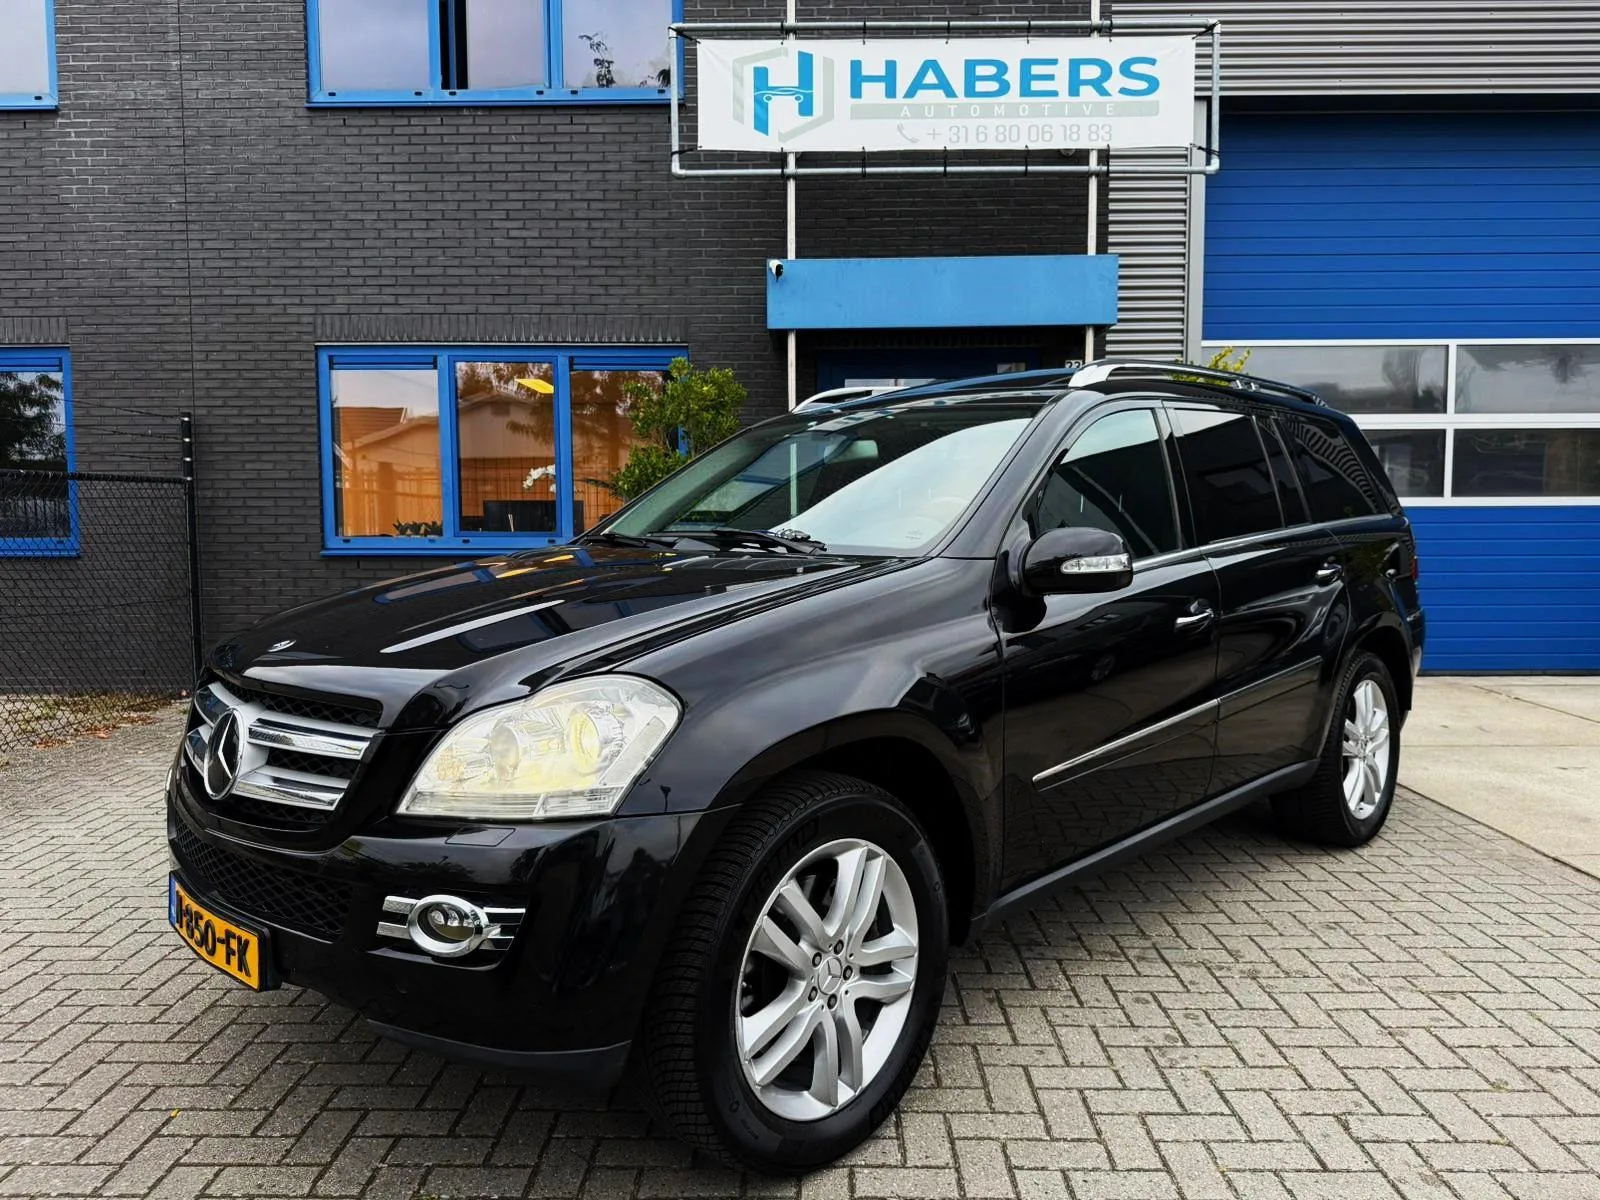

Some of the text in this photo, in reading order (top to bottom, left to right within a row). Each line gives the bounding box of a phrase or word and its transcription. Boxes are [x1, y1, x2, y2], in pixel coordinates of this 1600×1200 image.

[849, 56, 1160, 99] HABERS
[900, 104, 1115, 117] AUTOMOTIVE
[949, 125, 969, 144] 31
[975, 125, 988, 143] 6
[995, 125, 1021, 143] 80
[1027, 125, 1054, 143] 06
[1060, 124, 1081, 143] 18
[1087, 124, 1113, 142] 83
